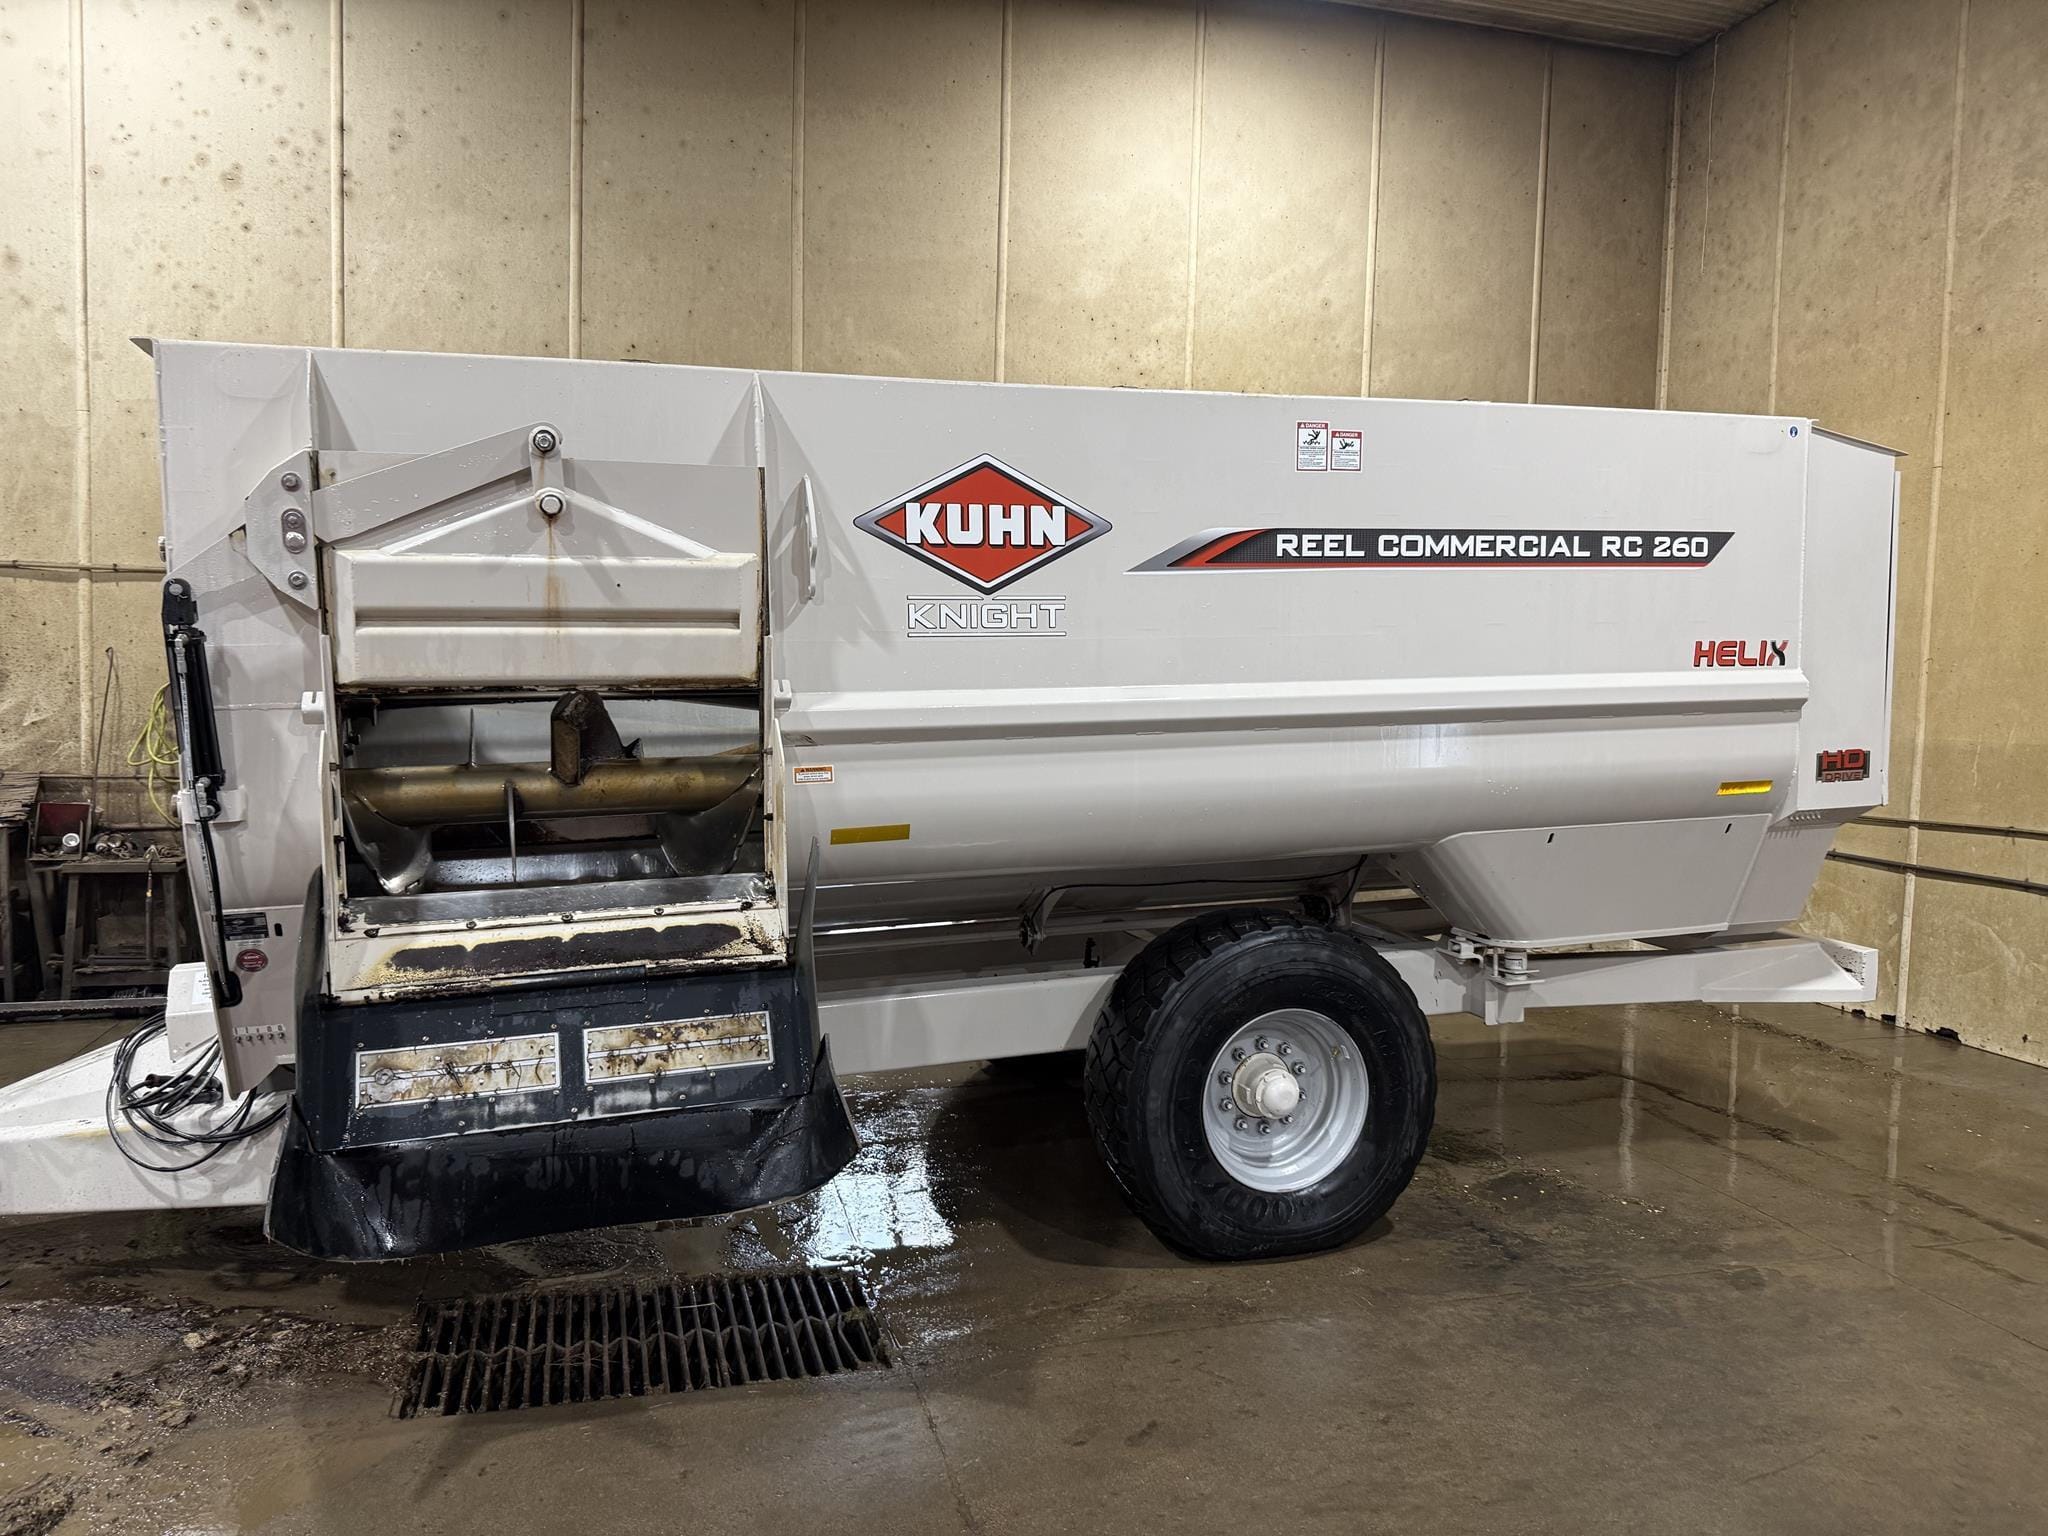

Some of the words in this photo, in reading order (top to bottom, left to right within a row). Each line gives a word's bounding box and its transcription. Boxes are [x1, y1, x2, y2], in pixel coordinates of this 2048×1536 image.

[905, 502, 1066, 547] KUHN
[1276, 534, 1365, 557] REEL
[1378, 534, 1591, 557] COMMERCIAL
[1601, 535, 1643, 557] RC
[1653, 536, 1709, 557] 260
[907, 603, 1066, 629] KNIGHT
[1693, 639, 1789, 667] HELIX
[1822, 749, 1865, 769] HD
[1824, 771, 1862, 782] DRIVE
